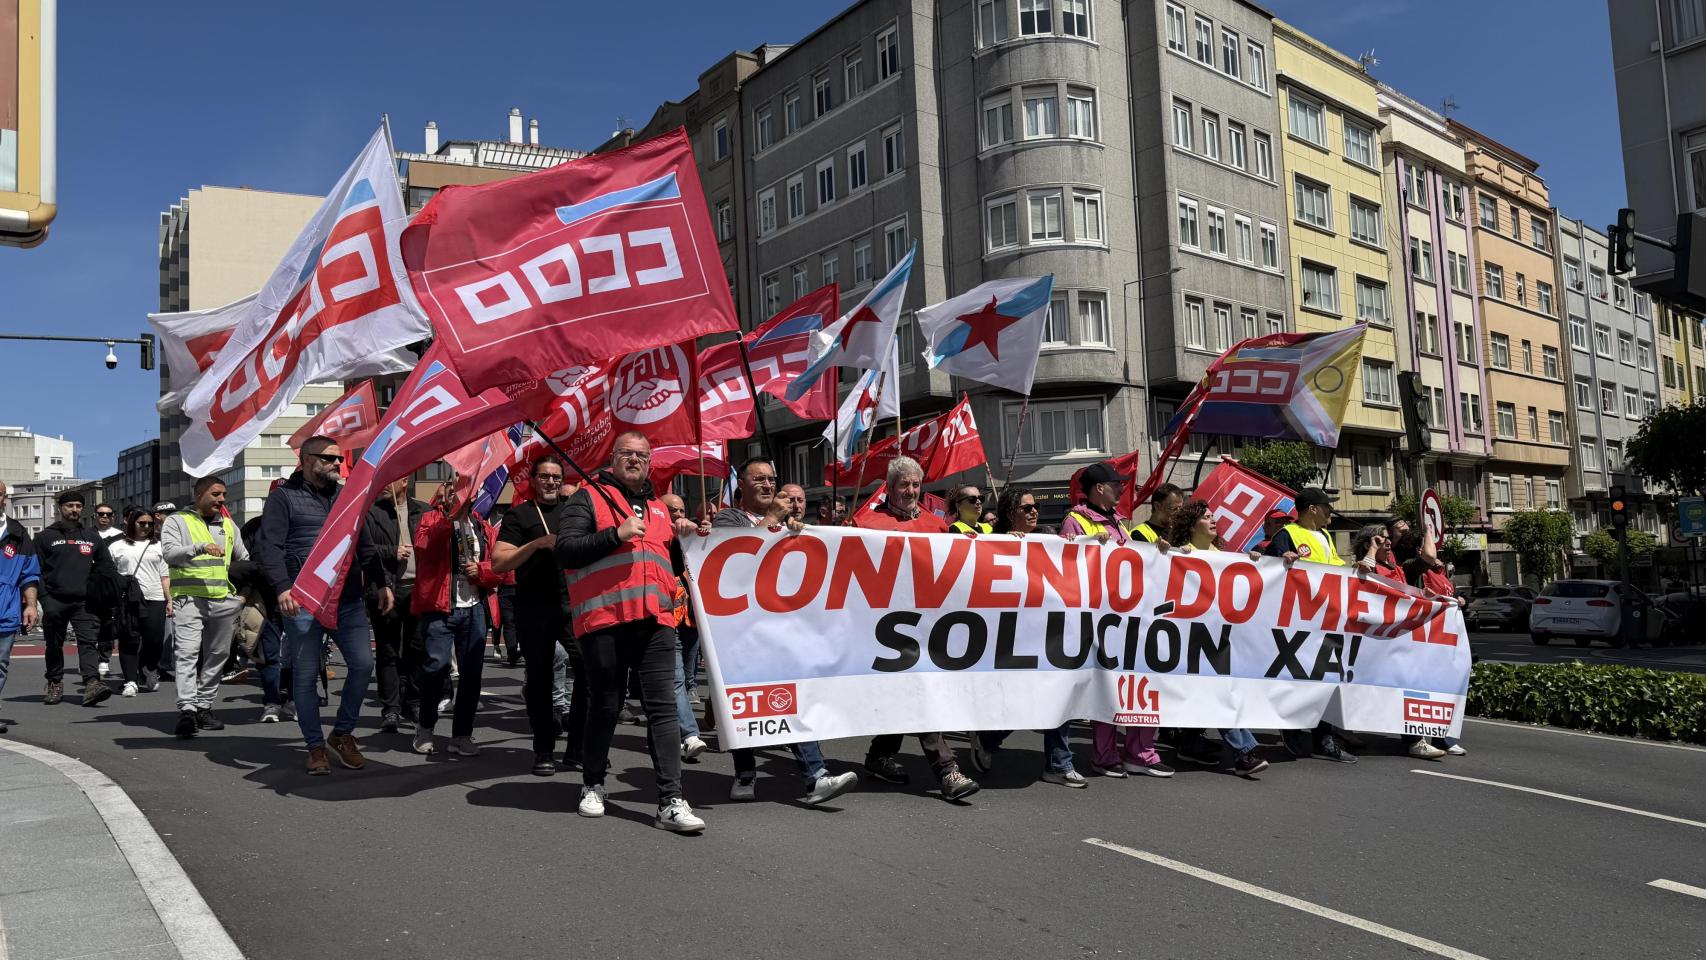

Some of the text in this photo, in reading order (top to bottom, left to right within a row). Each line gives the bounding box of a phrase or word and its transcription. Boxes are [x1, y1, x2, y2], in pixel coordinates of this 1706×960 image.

[698, 534, 1460, 646] CONVENIO DO METAL
[872, 601, 1362, 683] SOLUCIÓN XA!
[728, 690, 764, 716] GT
[1117, 674, 1159, 712] CIG
[1114, 714, 1159, 724] INDUSTRIA
[1408, 703, 1453, 721] CCOO
[748, 718, 791, 737] FICA
[1404, 721, 1450, 738] industri
